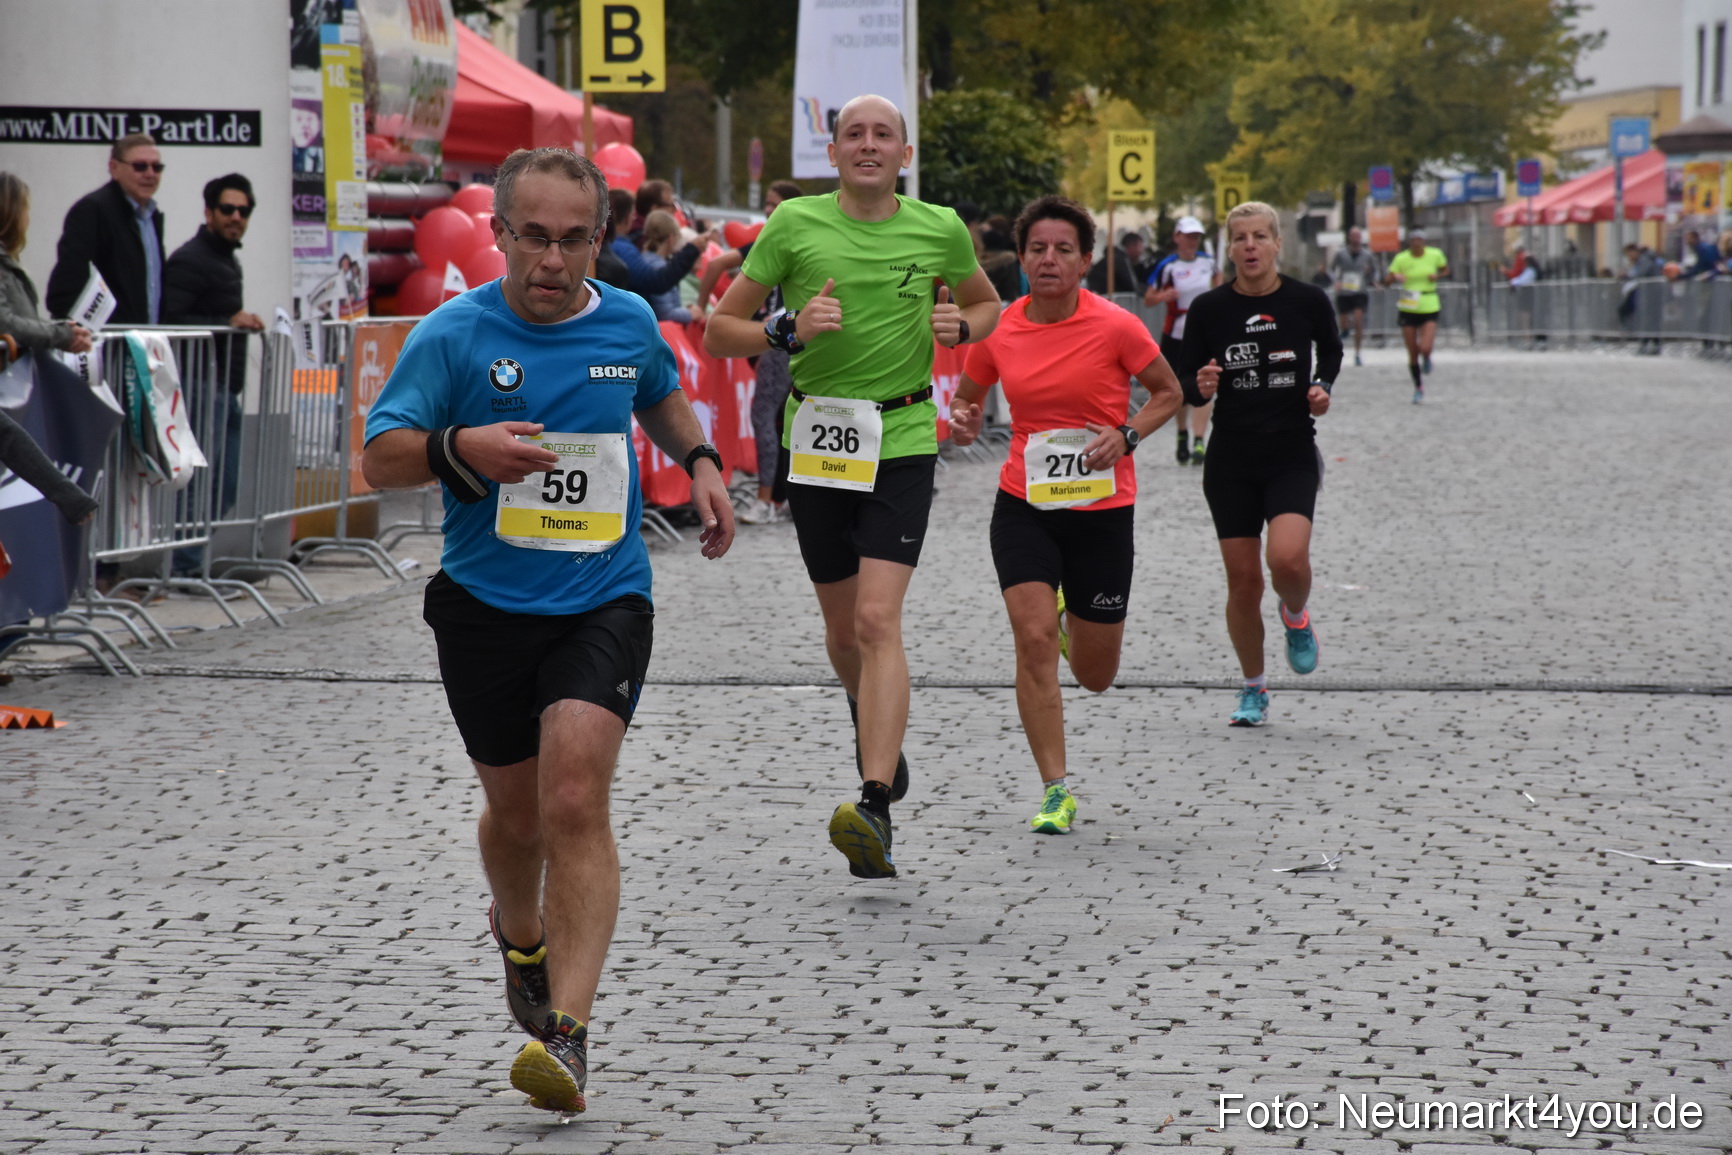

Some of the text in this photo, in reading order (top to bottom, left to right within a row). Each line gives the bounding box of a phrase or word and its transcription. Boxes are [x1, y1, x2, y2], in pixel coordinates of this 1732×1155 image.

[603, 4, 643, 63] B
[1114, 135, 1148, 146] Block
[1120, 152, 1142, 184] C
[1224, 187, 1241, 211] D
[898, 292, 918, 300] DAVID
[1245, 322, 1278, 334] skinfit
[491, 359, 520, 371] BMW
[588, 365, 638, 380] BOCK
[491, 396, 527, 407] PARTL
[491, 405, 527, 414] Neumarkt
[824, 406, 855, 416] BOCK
[811, 424, 860, 454] 236
[554, 443, 597, 454] BOCK
[821, 460, 847, 473] David
[1045, 453, 1092, 478] 270
[541, 469, 588, 505] 59
[1050, 485, 1091, 496] Marianne
[540, 515, 589, 531] Thomas
[1093, 592, 1124, 605] live
